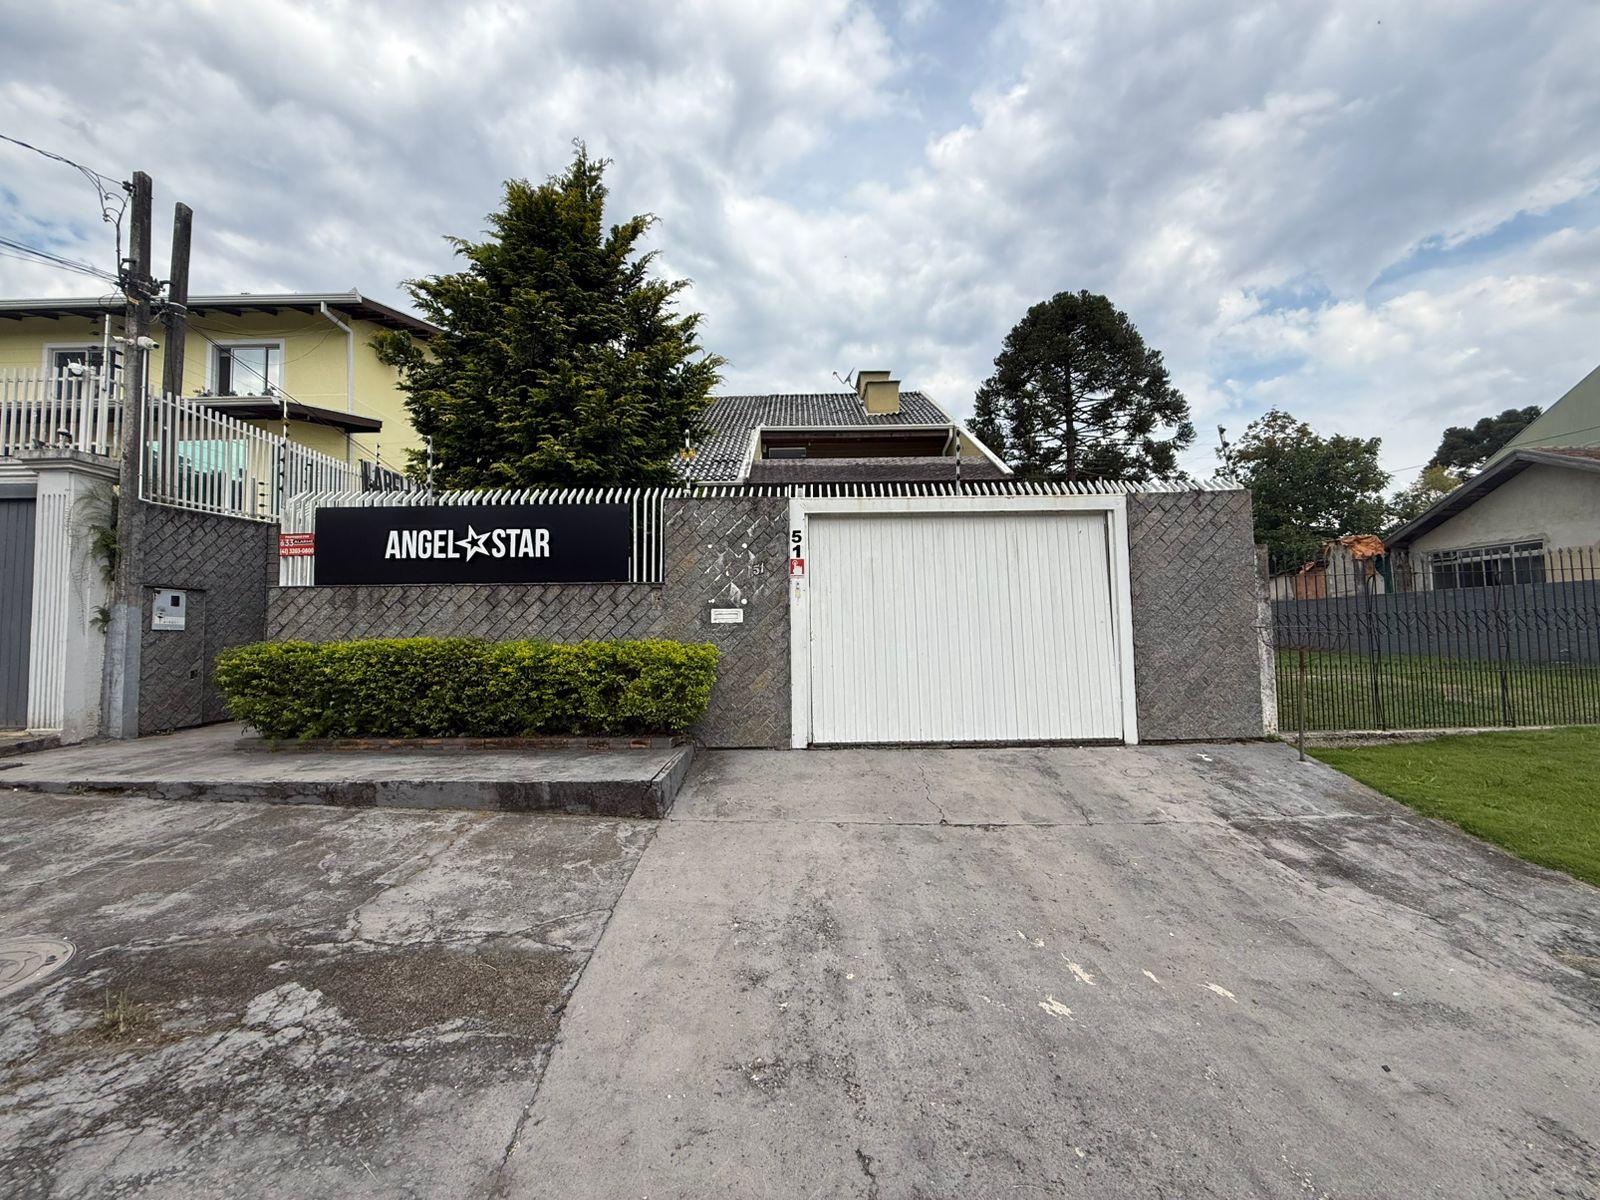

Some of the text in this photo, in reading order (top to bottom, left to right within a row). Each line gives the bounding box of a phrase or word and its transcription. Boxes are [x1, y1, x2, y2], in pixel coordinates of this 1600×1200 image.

[384, 528, 551, 559] ANGEL STAR
[753, 562, 765, 575] 51
